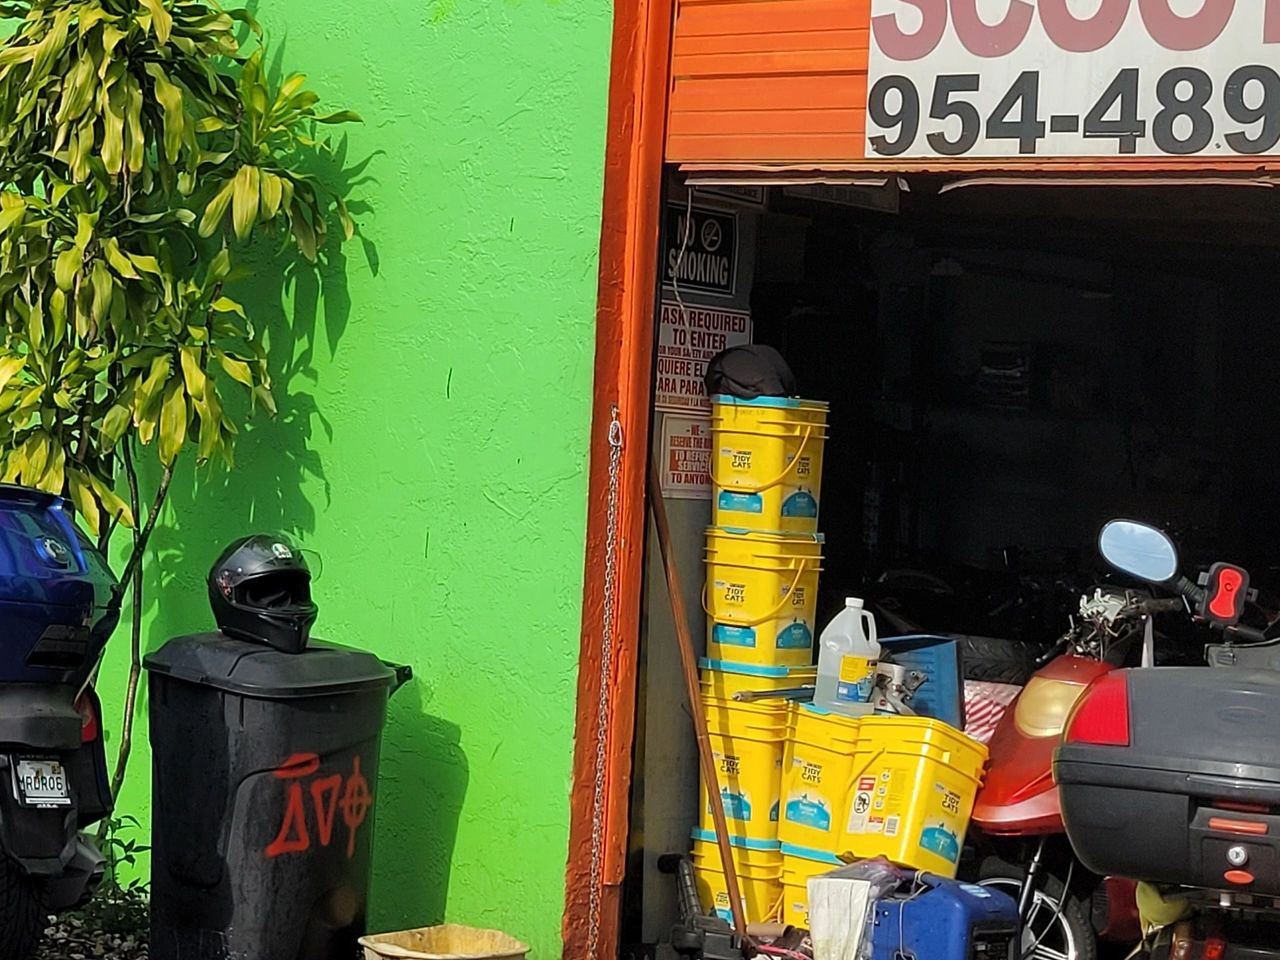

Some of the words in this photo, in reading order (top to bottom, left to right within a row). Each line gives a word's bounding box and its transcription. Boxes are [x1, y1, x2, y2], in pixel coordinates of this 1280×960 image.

[677, 215, 696, 248] NO
[668, 247, 729, 286] SMOKING
[688, 310, 746, 333] REQUIRED
[673, 328, 686, 346] TO
[690, 330, 727, 351] ENTER
[694, 363, 705, 378] EL
[679, 379, 704, 397] PARA
[731, 461, 751, 469] CATS
[672, 473, 682, 483] TO
[726, 587, 744, 595] TIDY
[724, 594, 745, 603] CATS
[721, 758, 740, 768] TIDY
[720, 766, 741, 775] CATS
[803, 766, 821, 777] TIDY
[801, 773, 822, 784] CATS
[943, 793, 960, 806] TIDY
[941, 800, 959, 814] CATS
